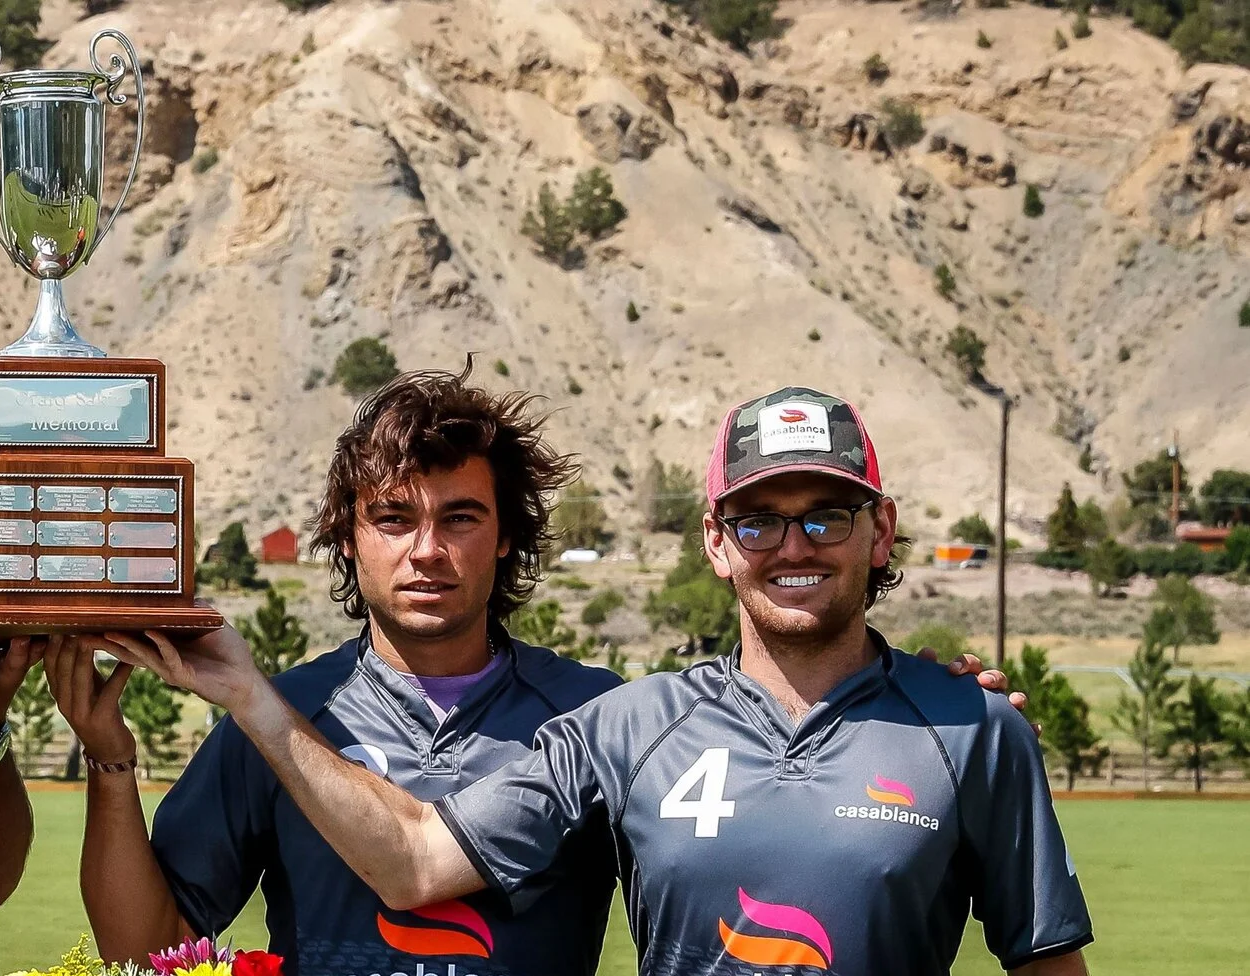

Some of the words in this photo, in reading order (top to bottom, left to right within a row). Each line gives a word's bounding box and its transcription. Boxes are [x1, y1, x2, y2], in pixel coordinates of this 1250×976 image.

[31, 418, 120, 432] Memorial
[659, 747, 736, 838] 4
[834, 803, 940, 831] casablanca
